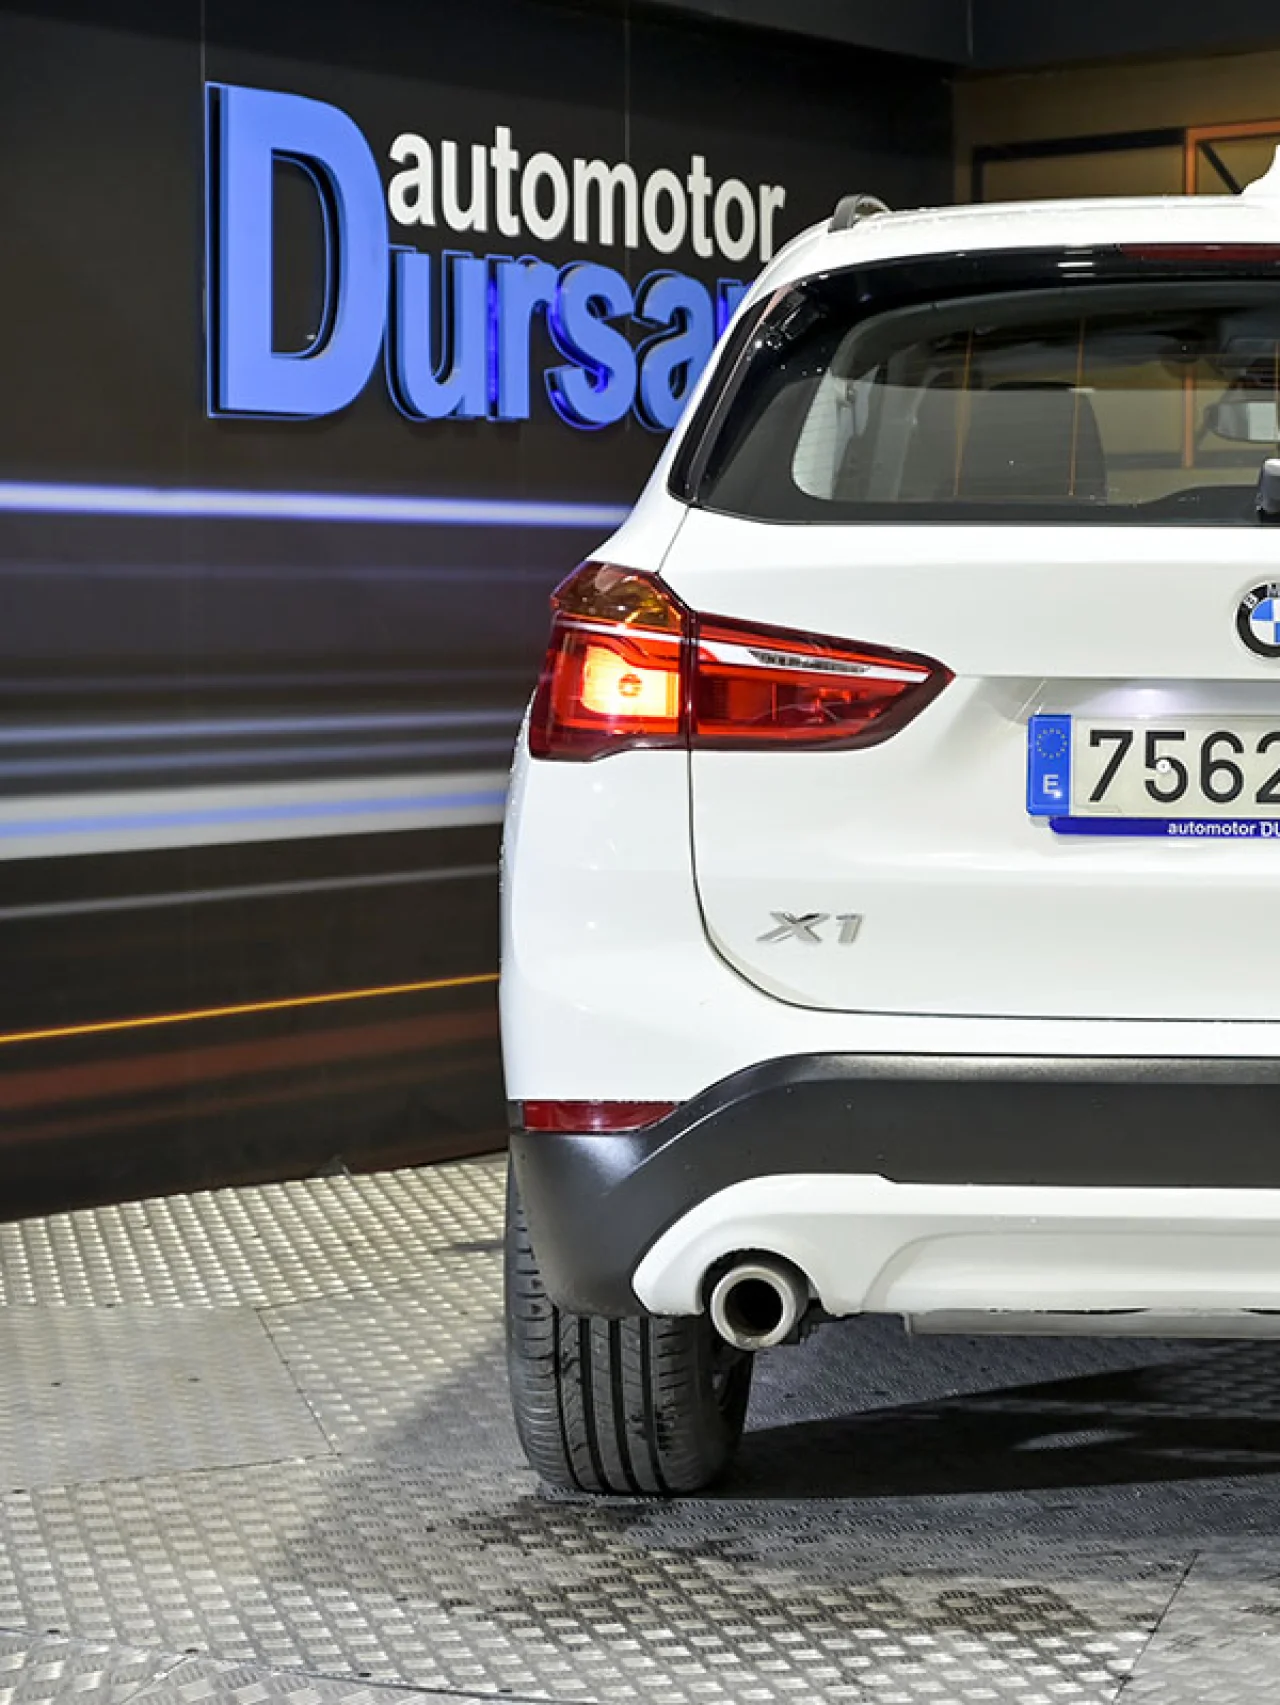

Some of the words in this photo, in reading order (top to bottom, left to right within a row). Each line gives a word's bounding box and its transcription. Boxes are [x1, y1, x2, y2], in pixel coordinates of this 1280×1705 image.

[388, 125, 786, 263] automotor
[205, 81, 755, 432] Dursa
[1042, 775, 1059, 796] E
[1167, 820, 1257, 837] automotor
[756, 911, 864, 944] X1
